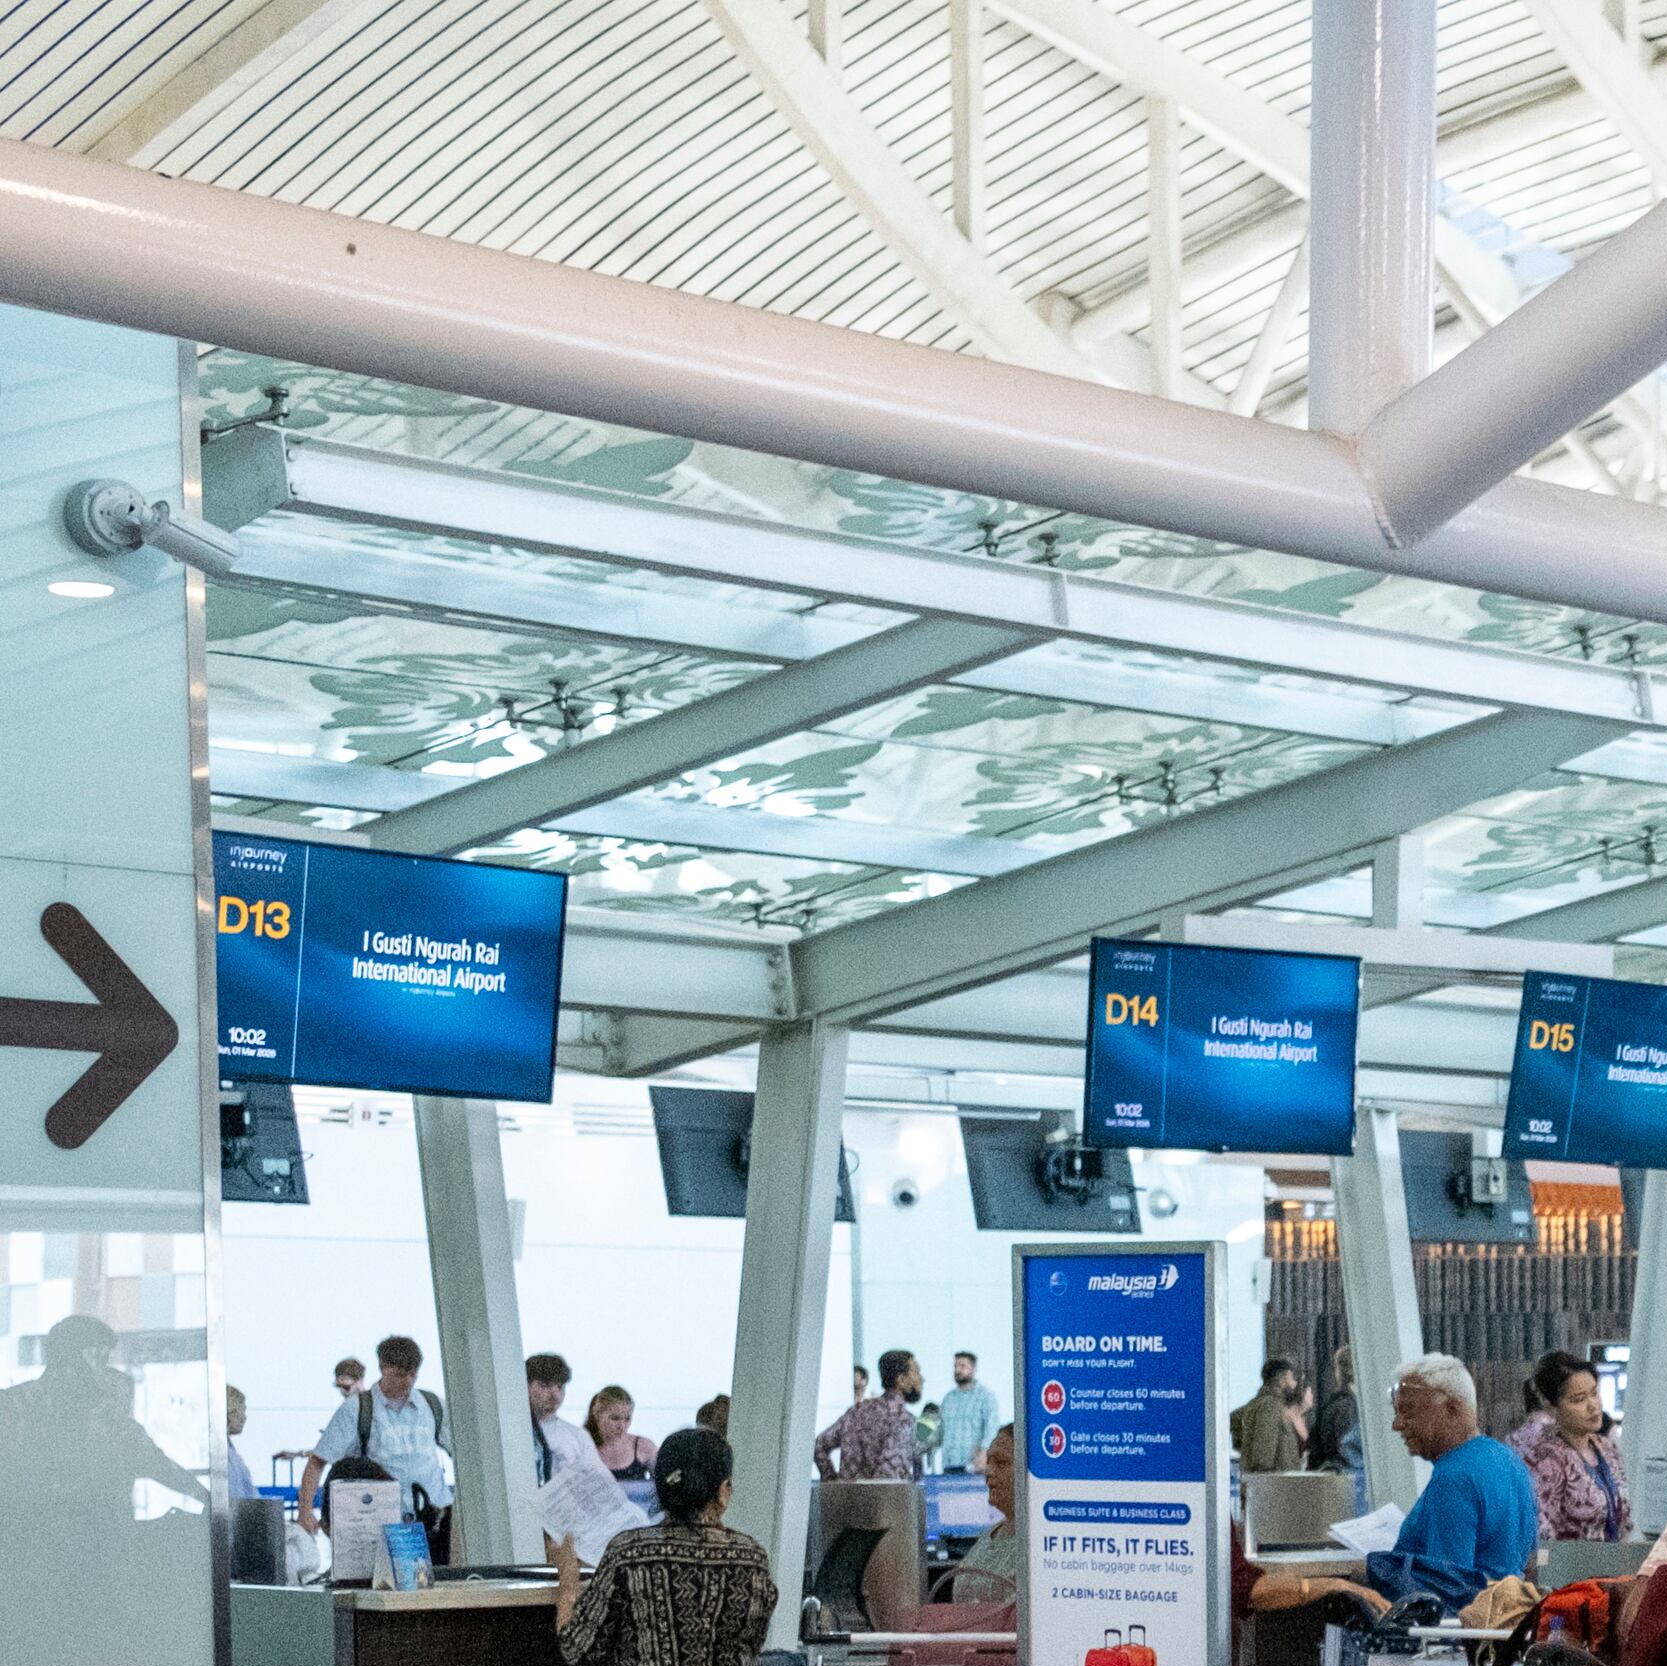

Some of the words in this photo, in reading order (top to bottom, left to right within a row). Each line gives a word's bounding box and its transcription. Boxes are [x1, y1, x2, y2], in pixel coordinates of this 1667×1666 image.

[229, 846, 287, 865] injourney
[231, 860, 283, 873] AIRPORTS
[217, 895, 291, 940] D13
[363, 930, 369, 952] I
[372, 931, 412, 957] Gusti
[415, 936, 472, 964] Ngurah
[475, 942, 500, 965] Rai
[352, 957, 452, 987] International
[453, 966, 506, 996] Airport
[1105, 992, 1159, 1028] D14
[228, 1027, 267, 1046] 10:02
[1211, 1016, 1217, 1034] I
[1218, 1016, 1248, 1036] Gusti
[1249, 1018, 1292, 1041] Ngurah
[1293, 1020, 1313, 1040] Rai
[1529, 1019, 1575, 1052] D15
[1204, 1039, 1277, 1061] International
[1279, 1042, 1318, 1066] Airport
[1616, 1044, 1622, 1060] I
[1622, 1045, 1648, 1062] Gusti
[1088, 1272, 1157, 1296] malaysia
[1042, 1335, 1097, 1352] BOARD
[1100, 1335, 1123, 1352] ON
[1126, 1335, 1167, 1352] TIME.
[1042, 1359, 1065, 1368] DON'T
[1066, 1359, 1084, 1368] MISS
[1086, 1359, 1107, 1368] YOUR
[1108, 1359, 1136, 1368] FLIGHT.
[1047, 1392, 1060, 1402] 60
[1070, 1387, 1105, 1399] Counter
[1106, 1388, 1133, 1399] closes
[1136, 1388, 1148, 1399] 60
[1150, 1388, 1185, 1399] minutes
[1070, 1400, 1099, 1410] before
[1100, 1401, 1146, 1412] departure.
[1070, 1431, 1091, 1442] Gate
[1092, 1432, 1119, 1443] closes
[1122, 1432, 1134, 1443] 30
[1135, 1433, 1171, 1444] minutes
[1070, 1444, 1099, 1454] before
[1101, 1445, 1146, 1456] departure.
[1048, 1506, 1086, 1517] BUSINESS
[1088, 1507, 1110, 1518] SUITE
[1119, 1507, 1158, 1518] BUSINESS
[1160, 1508, 1187, 1519] CLASS
[1043, 1536, 1058, 1552] IF
[1062, 1536, 1077, 1553] IT
[1082, 1537, 1121, 1557] FITS,
[1125, 1538, 1140, 1554] IT
[1145, 1539, 1194, 1557] FLIES.
[1043, 1558, 1057, 1570] No
[1061, 1559, 1089, 1571] cabin
[1091, 1558, 1136, 1575] baggage
[1138, 1562, 1161, 1574] over
[1164, 1560, 1194, 1577] 14kgs
[1052, 1587, 1059, 1598] 2
[1061, 1588, 1122, 1600] CABIN-SIZE
[1125, 1590, 1178, 1603] BAGGAGE
